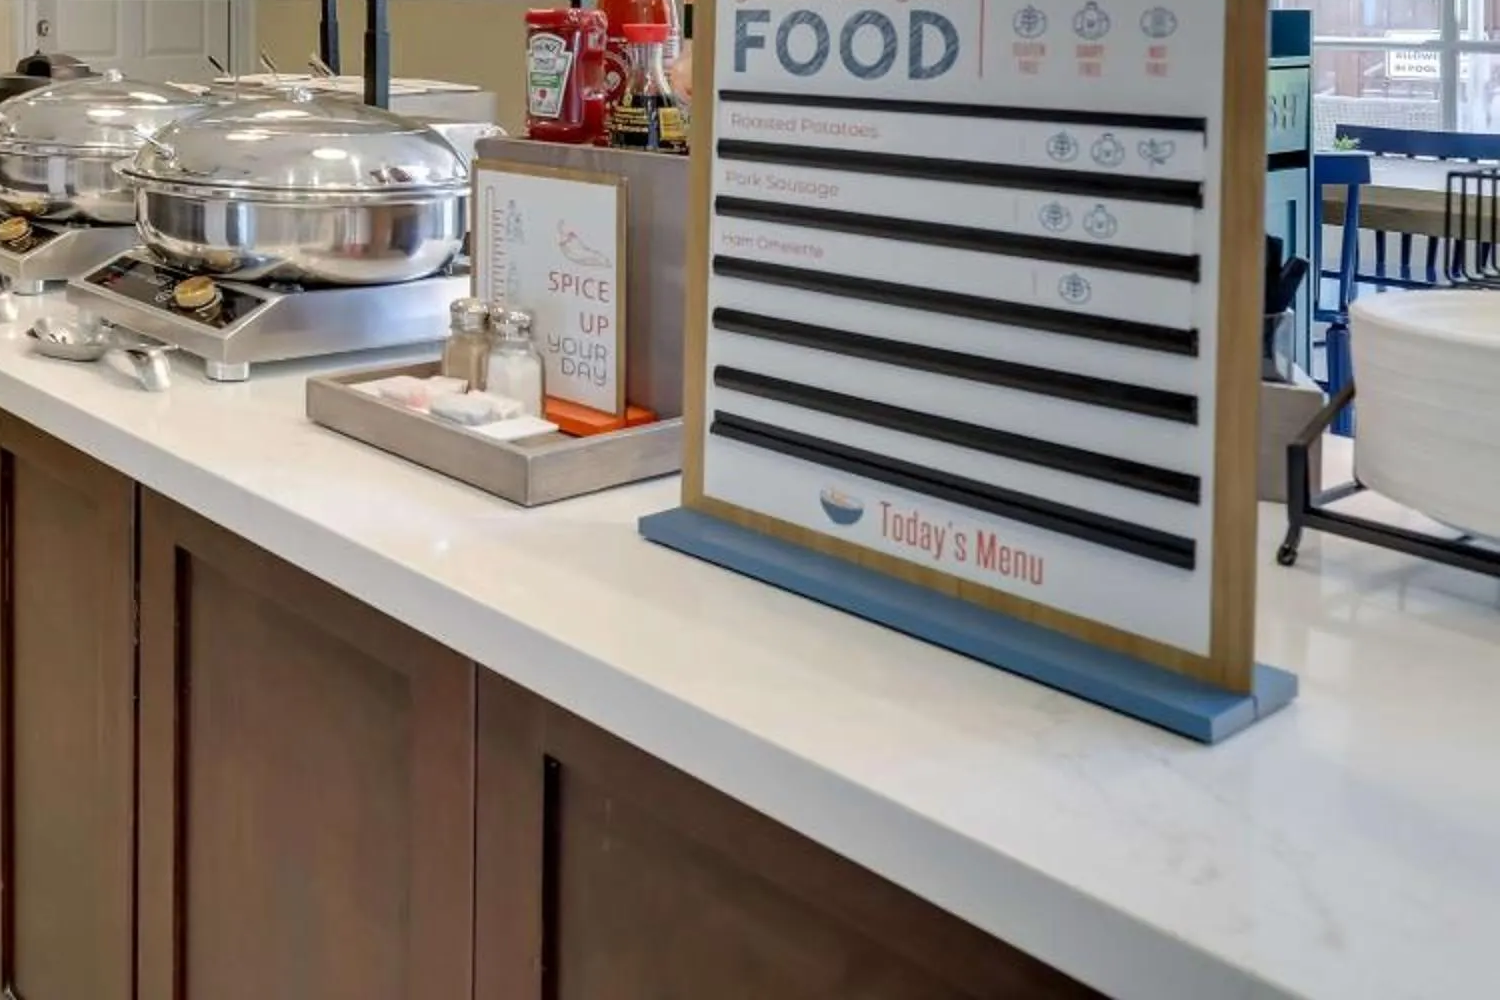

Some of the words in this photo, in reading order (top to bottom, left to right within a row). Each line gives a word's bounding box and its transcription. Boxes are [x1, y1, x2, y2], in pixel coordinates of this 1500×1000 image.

[733, 8, 961, 81] FOOD
[731, 113, 797, 132] Roasted
[801, 117, 881, 139] Potatoes
[766, 175, 840, 199] Sausage
[722, 231, 754, 247] Ham
[548, 271, 610, 303] SPICE
[580, 311, 609, 337] UP
[547, 333, 607, 362] YOUR
[561, 357, 607, 387] DAY
[880, 501, 968, 561] Today's
[976, 529, 1044, 585] Menu
